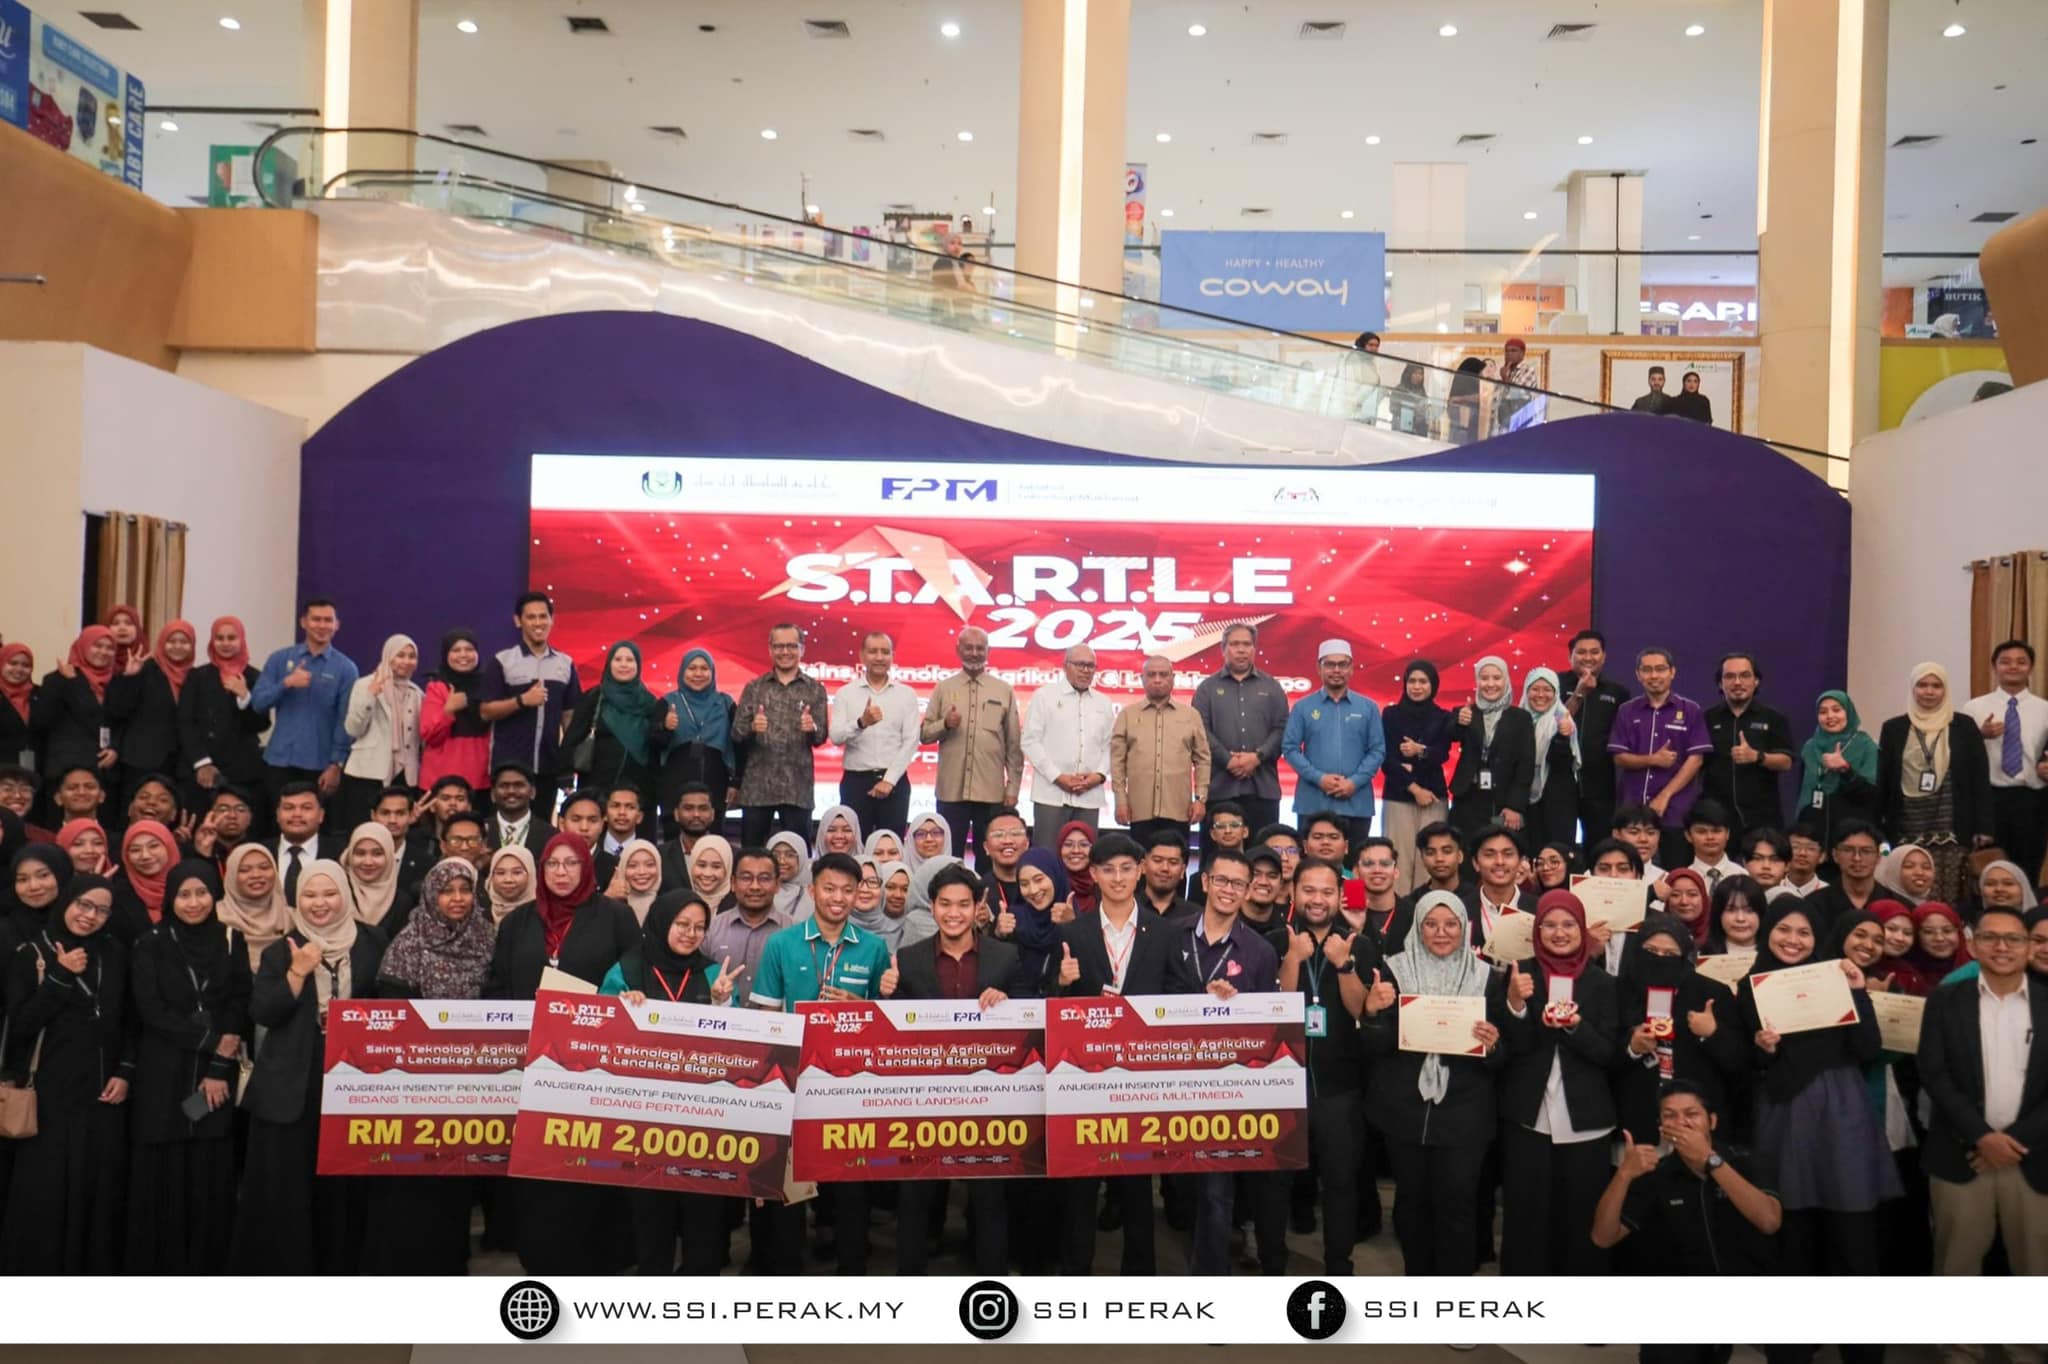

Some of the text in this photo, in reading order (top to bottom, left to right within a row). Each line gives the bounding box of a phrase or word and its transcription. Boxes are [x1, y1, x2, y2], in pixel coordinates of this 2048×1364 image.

[127, 82, 143, 191] ABY CARE
[1225, 259, 1325, 268] HAPPY HEALTHY
[1200, 278, 1348, 306] coway
[1944, 293, 1982, 301] BUTIK
[1640, 301, 1757, 321] SARI
[786, 553, 1294, 605] S.T.A.R.T.L.E
[986, 607, 1202, 651] 2025
[366, 1021, 395, 1031] 2025
[571, 1015, 603, 1027] 2025
[833, 1022, 862, 1033] 2025
[1084, 1018, 1112, 1029] 2025
[366, 1044, 528, 1056] Sains, Teknologi, Agrikul
[835, 1044, 1017, 1057] Sains, Teknologi, Agrikultur
[1086, 1039, 1266, 1053] Sains, Teknologi, Agrikultur
[395, 1055, 518, 1065] & Landskap Ekspo
[570, 1041, 759, 1068] Sains, Teknologi, Agrikultur
[1116, 1051, 1237, 1062] & Landskap Ekspo
[599, 1054, 727, 1077] & Landskap Ekspo
[864, 1056, 987, 1067] & Landskap Ekspo
[805, 1084, 1044, 1096] ANUGERAH INSENTIF PENYELIDIKAN USAS
[1058, 1078, 1295, 1091] ANUGERAH INSENTIF PENYELIDIKAN USAS
[348, 1095, 519, 1104] BIDANG TEKNOLOGI MAKL
[534, 1079, 782, 1111] ANUGERAH INSENTIF PENYELIDIKAN USAS
[862, 1096, 989, 1107] BIDANG LANDSKAP
[1109, 1090, 1244, 1102] BIDANG MULTIMEDIA
[590, 1096, 725, 1118] BIDANG PERTANIAN
[348, 1119, 516, 1147] RM 2,000.
[822, 1119, 1029, 1151] RM 2,000.00
[1075, 1113, 1280, 1146] RM 2,000.00
[544, 1118, 760, 1164] RM 2,000.00
